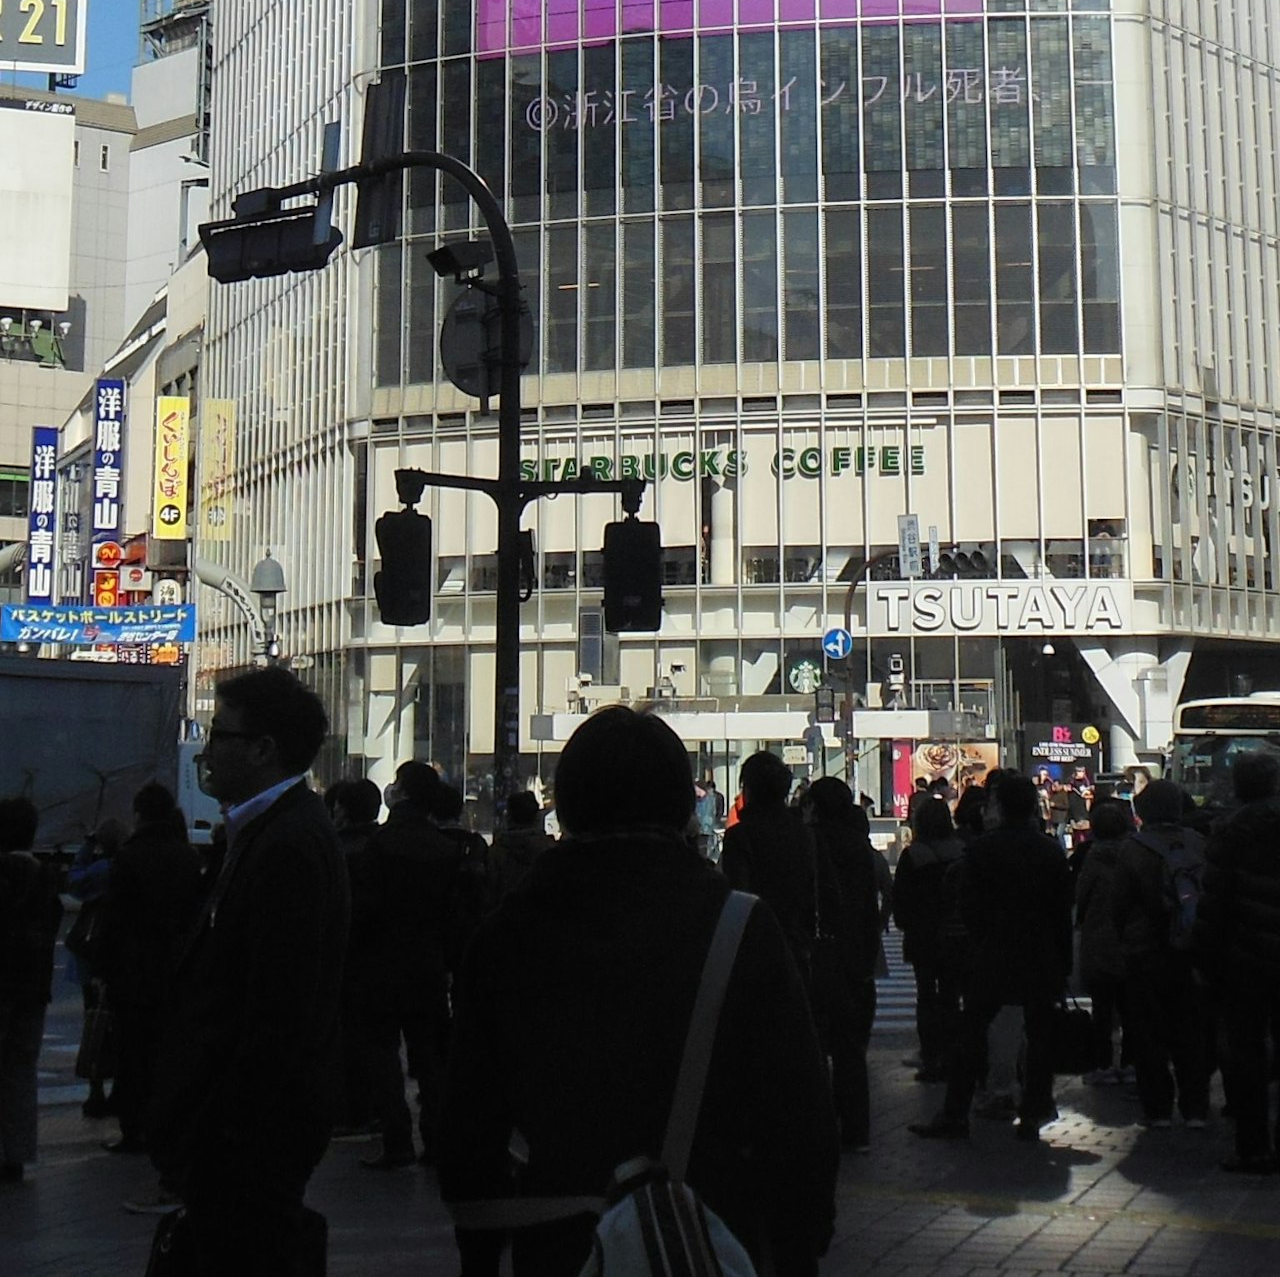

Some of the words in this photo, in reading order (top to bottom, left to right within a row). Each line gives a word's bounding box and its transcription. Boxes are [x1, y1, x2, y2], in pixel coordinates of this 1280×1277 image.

[93, 388, 122, 531] 洋服の青山
[520, 446, 748, 483] STARBUCKS
[771, 444, 927, 478] COFFEE
[29, 444, 57, 598] 洋服の青山
[160, 507, 180, 522] 4F
[11, 607, 188, 624] バスケットボールストリート
[877, 586, 1123, 631] TSUTAYA
